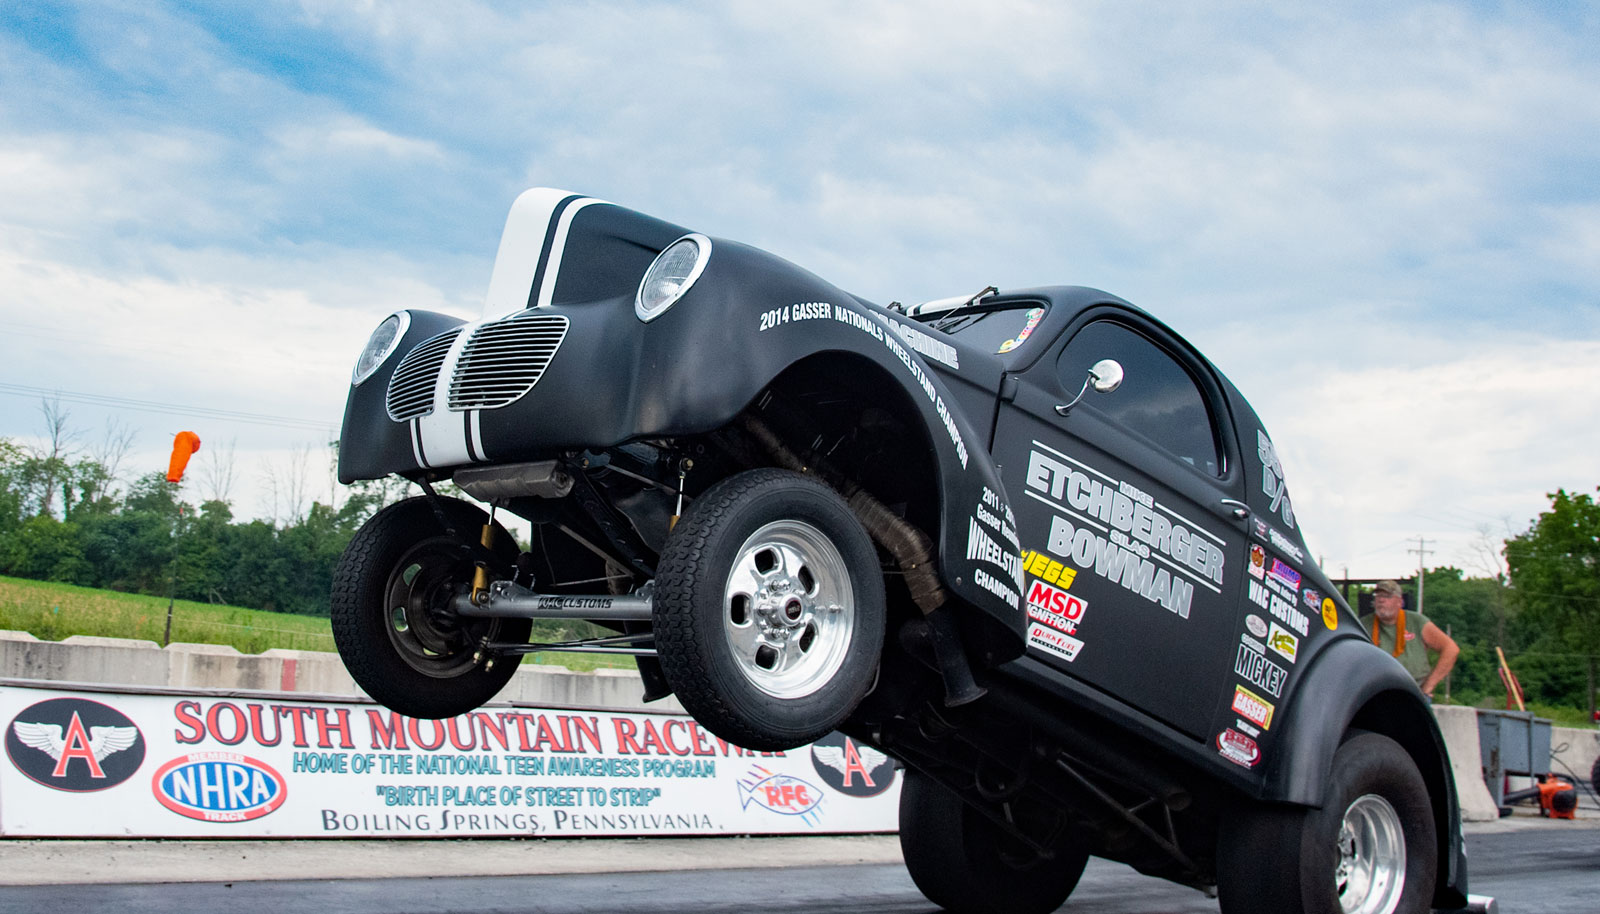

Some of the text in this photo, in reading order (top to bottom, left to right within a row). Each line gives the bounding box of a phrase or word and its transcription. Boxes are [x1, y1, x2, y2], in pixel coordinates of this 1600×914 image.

[868, 308, 960, 370] ACHINE
[759, 302, 969, 471] 2014 GASSER NATIONALS WHEELSTAND CHAMPION
[982, 486, 999, 511] 2011
[1119, 480, 1154, 509] MIKE
[977, 503, 1001, 532] Gasser
[1026, 449, 1225, 586] ETCHBERGER
[966, 515, 1025, 598] WHEELSTA
[1109, 529, 1151, 559] SILAS
[1020, 549, 1078, 590] JEGS
[1046, 514, 1194, 620] BOWMAN
[562, 597, 614, 609] CUSTOMS
[974, 568, 1020, 611] CHAMPION
[1028, 582, 1083, 621] MSD
[1248, 578, 1270, 610] WAC
[1269, 593, 1310, 637] CUSTOMS
[1234, 643, 1288, 698] MICKEY
[1233, 692, 1268, 723] GASSER
[174, 700, 788, 759] SOUTH MOUNTAIN RACE
[187, 751, 246, 763] MEMBER
[292, 752, 717, 779] HOME OF THE NATIONAL TEEN AWARENESS PROGRAM
[172, 763, 272, 810] NHRA
[376, 784, 662, 808] "BIRTH PLACE OF STREET TO STRIP"
[203, 811, 248, 822] TRACK
[321, 809, 432, 832] BOILING
[439, 808, 546, 832] SPRINGS,
